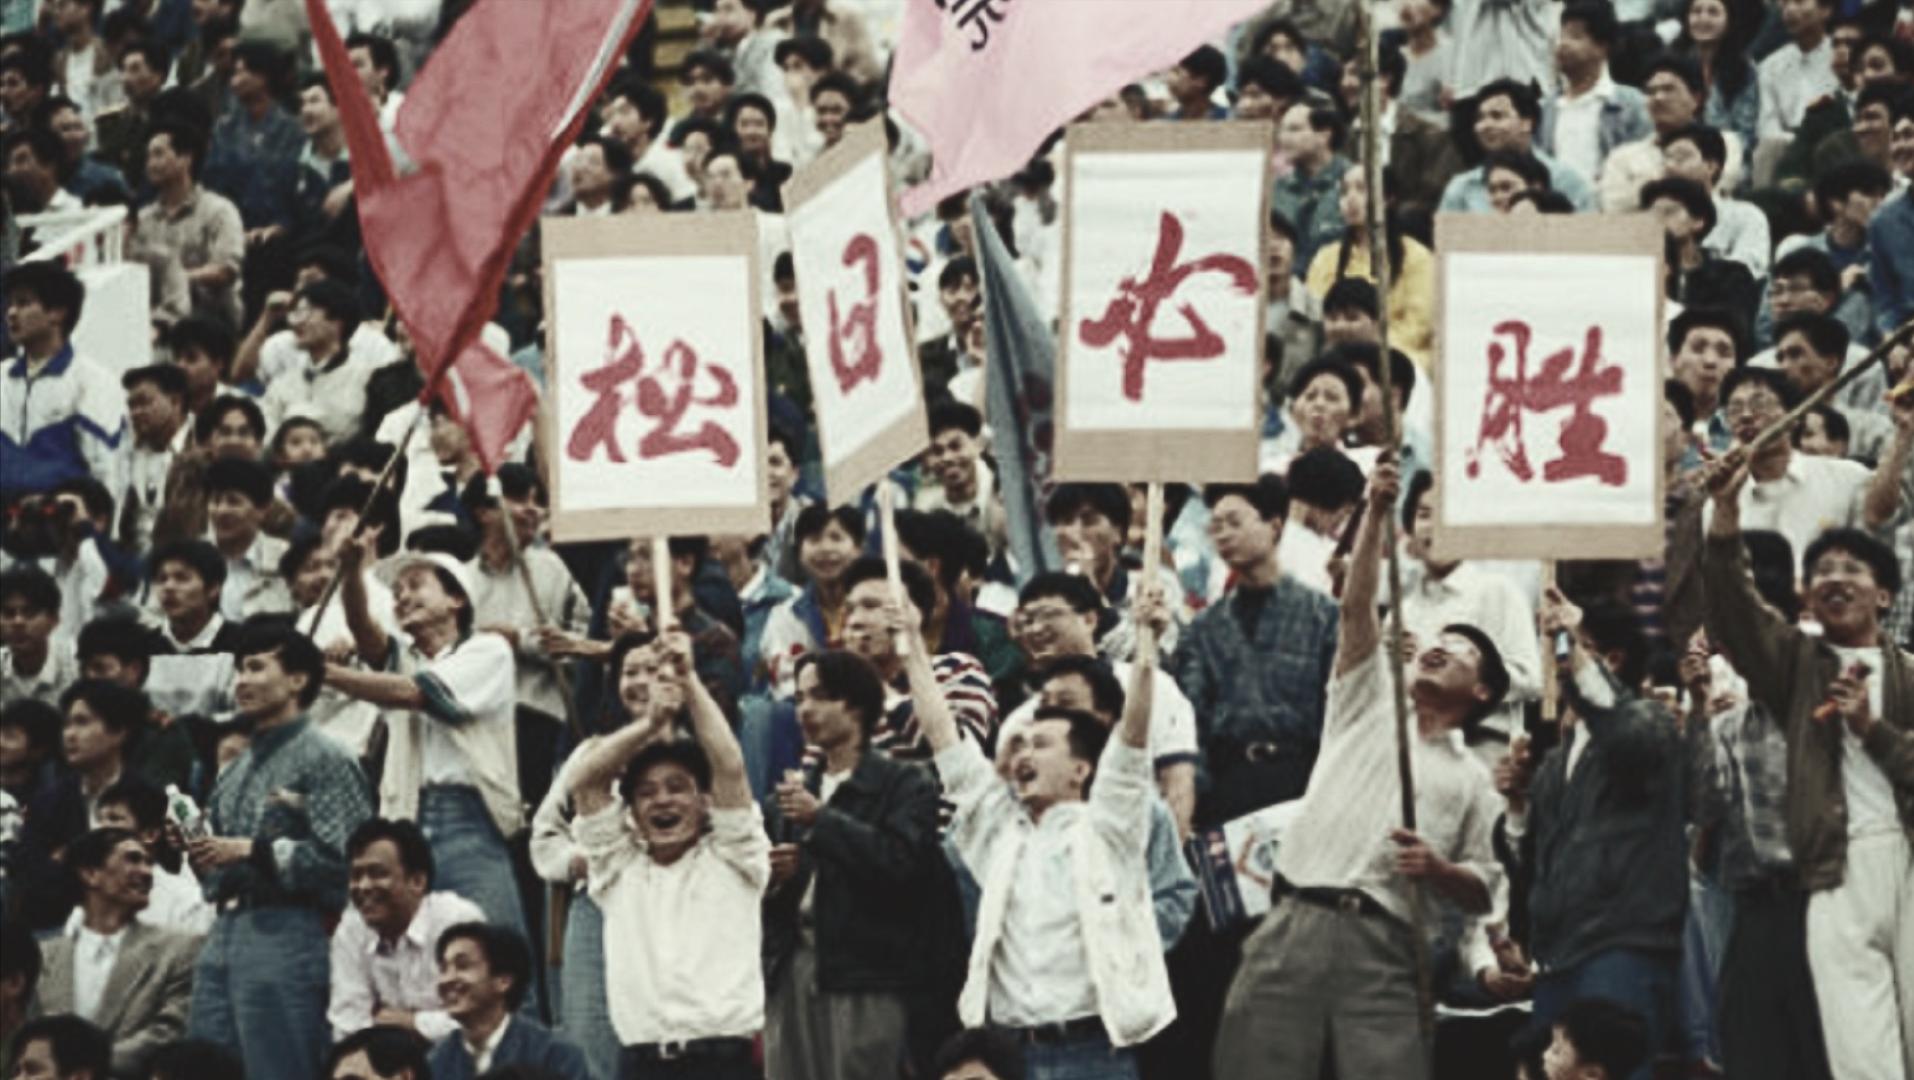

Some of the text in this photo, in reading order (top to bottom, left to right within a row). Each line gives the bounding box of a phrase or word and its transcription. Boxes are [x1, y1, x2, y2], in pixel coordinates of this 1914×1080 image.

[566, 210, 1628, 486] 松 日 必 胜
